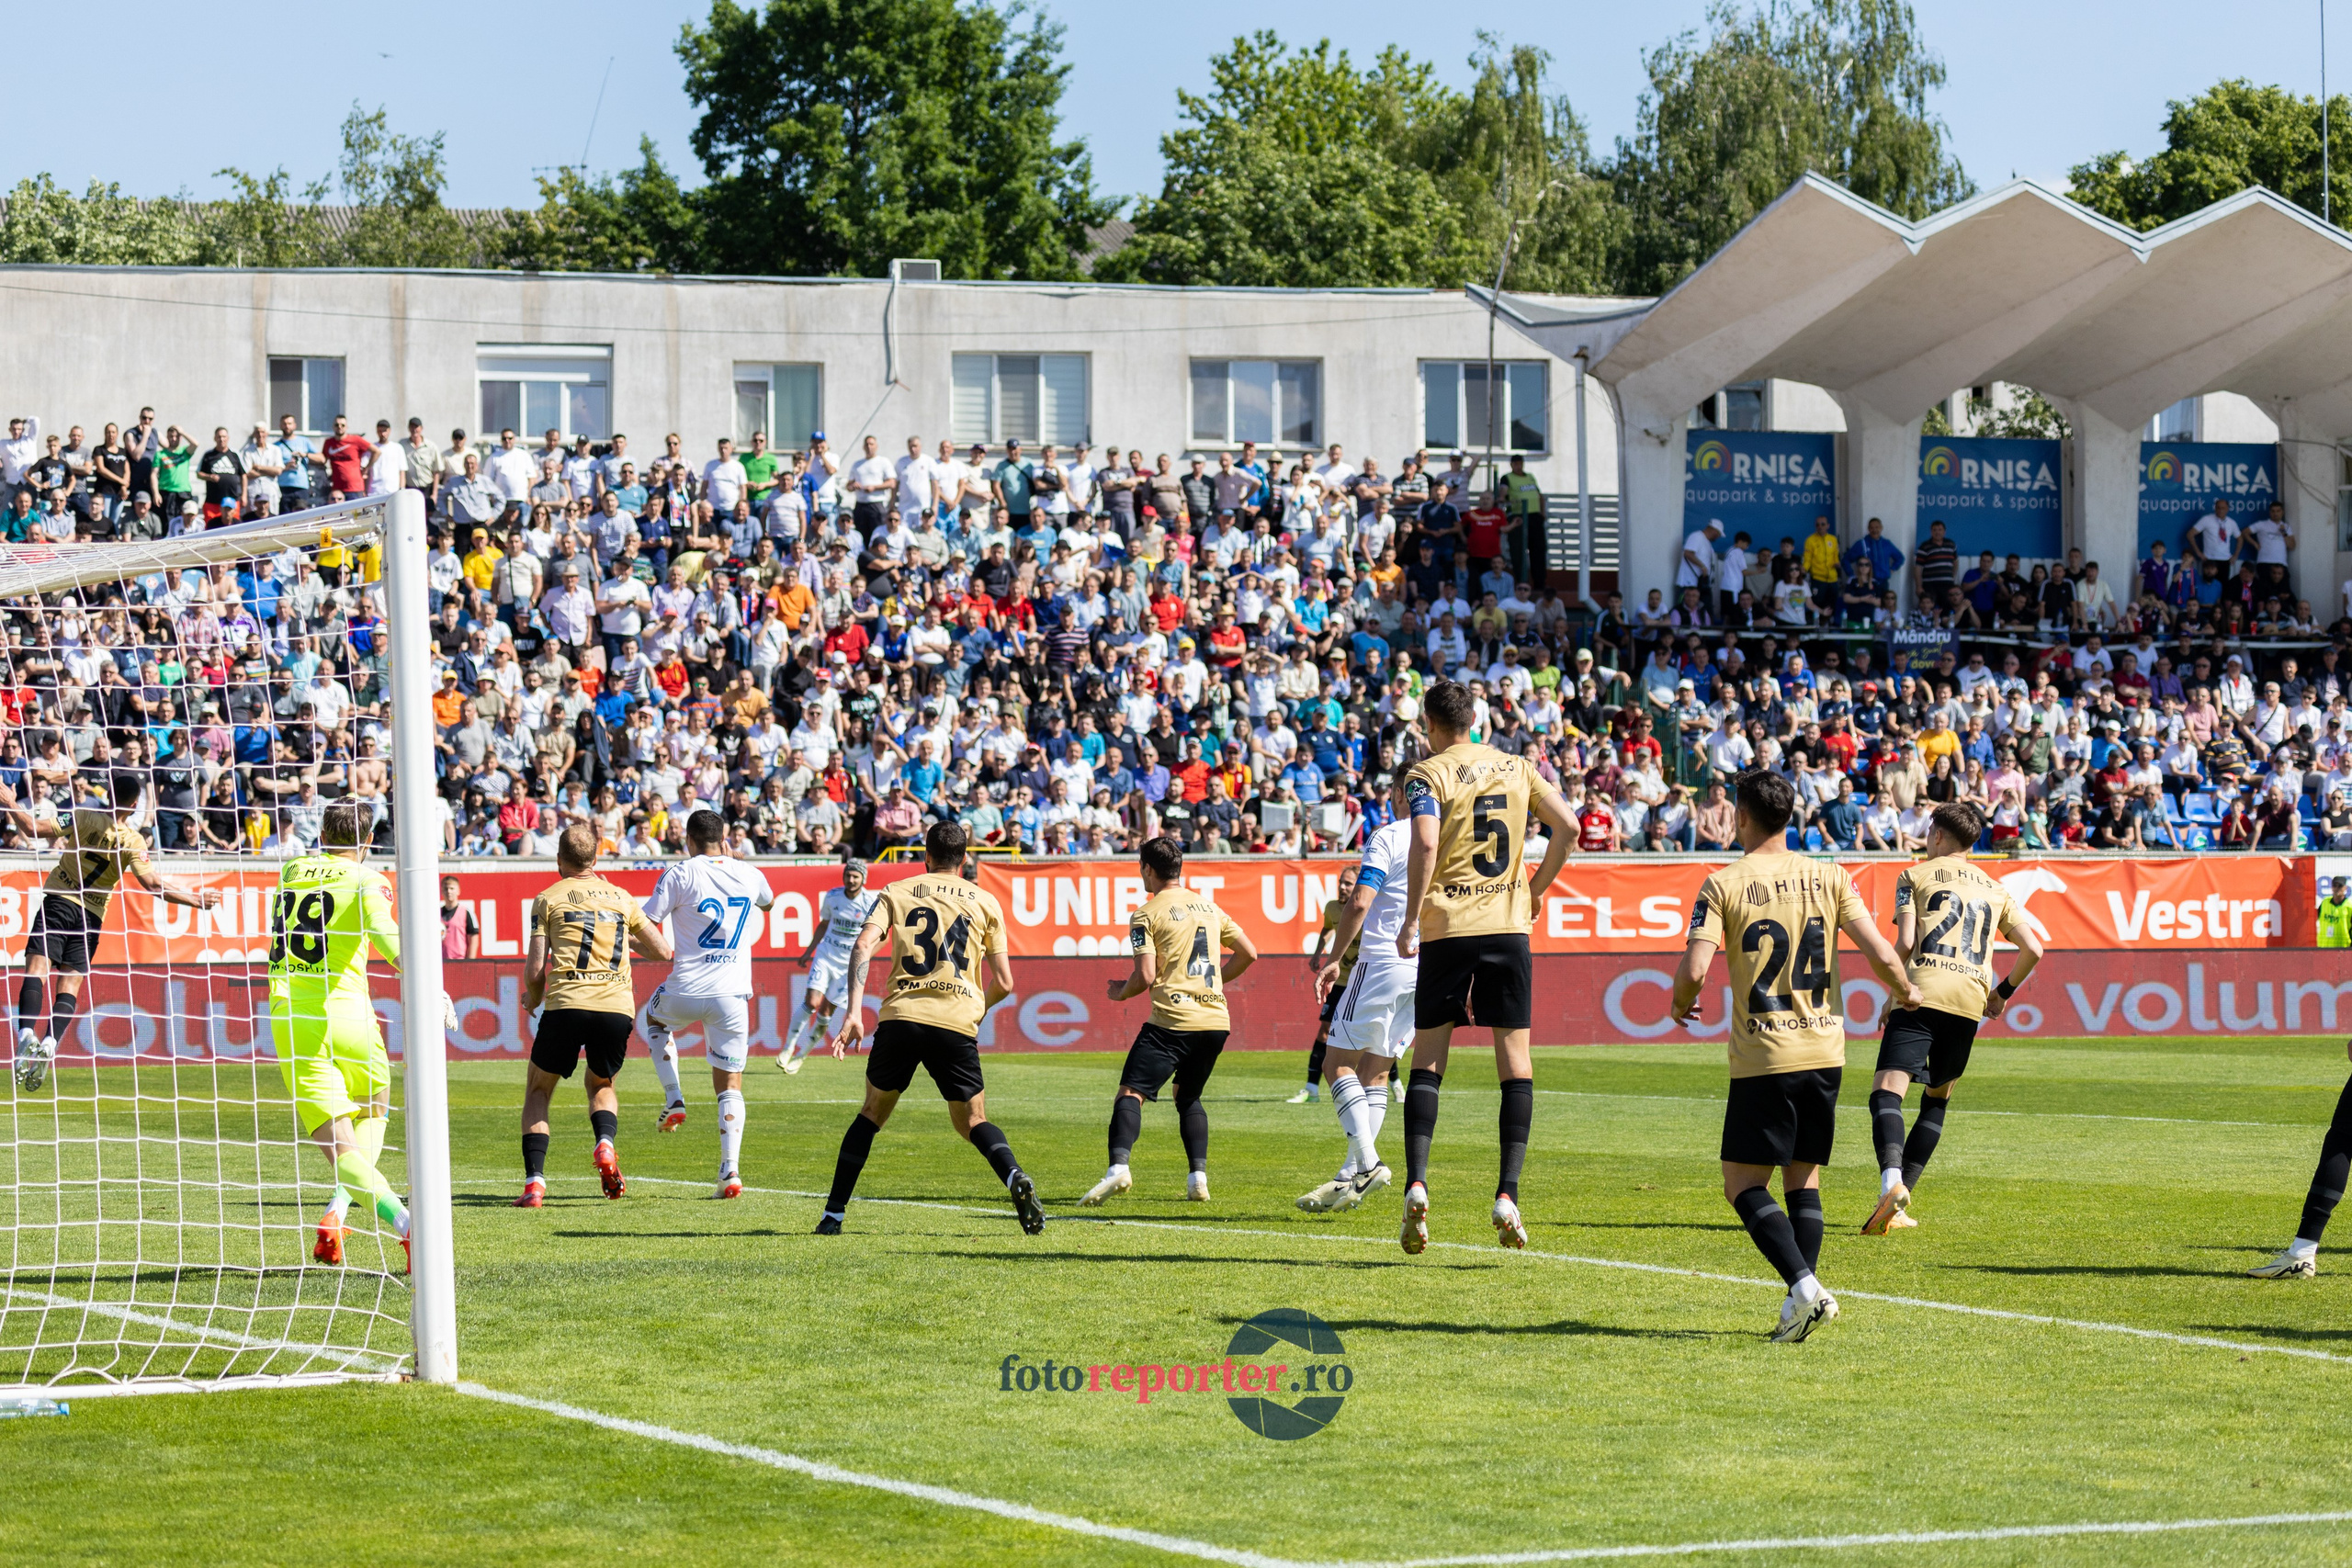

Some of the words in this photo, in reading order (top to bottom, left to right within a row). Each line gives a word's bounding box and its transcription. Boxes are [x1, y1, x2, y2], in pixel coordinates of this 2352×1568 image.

[1685, 488, 1757, 504] quapark
[1782, 490, 1832, 506] sports
[1917, 493, 1985, 510] quapark
[2010, 495, 2059, 512] sports
[2139, 497, 2206, 514] quapark
[2229, 499, 2273, 514] sport
[1893, 629, 1951, 644] Mândru
[1478, 761, 1515, 775] HILS
[1472, 794, 1510, 877] 5
[84, 851, 110, 888] 7
[1958, 869, 1993, 889] HILS
[936, 885, 976, 900] HILS
[1476, 879, 1522, 896] HOSPITA
[1774, 877, 1822, 894] HILS
[1185, 903, 1214, 913] HILS
[2105, 889, 2283, 942] Vestra
[696, 897, 752, 950] 27
[1920, 889, 1992, 965] 20
[563, 910, 626, 972] 77
[900, 906, 973, 981] 34
[1187, 926, 1216, 988] 4
[1742, 916, 1831, 1014] 24
[1940, 960, 1988, 984] HOSPITAL
[922, 979, 973, 998] HOSPITAL
[2065, 962, 2352, 1033] volum
[1776, 1015, 1837, 1032] HOSPITAL
